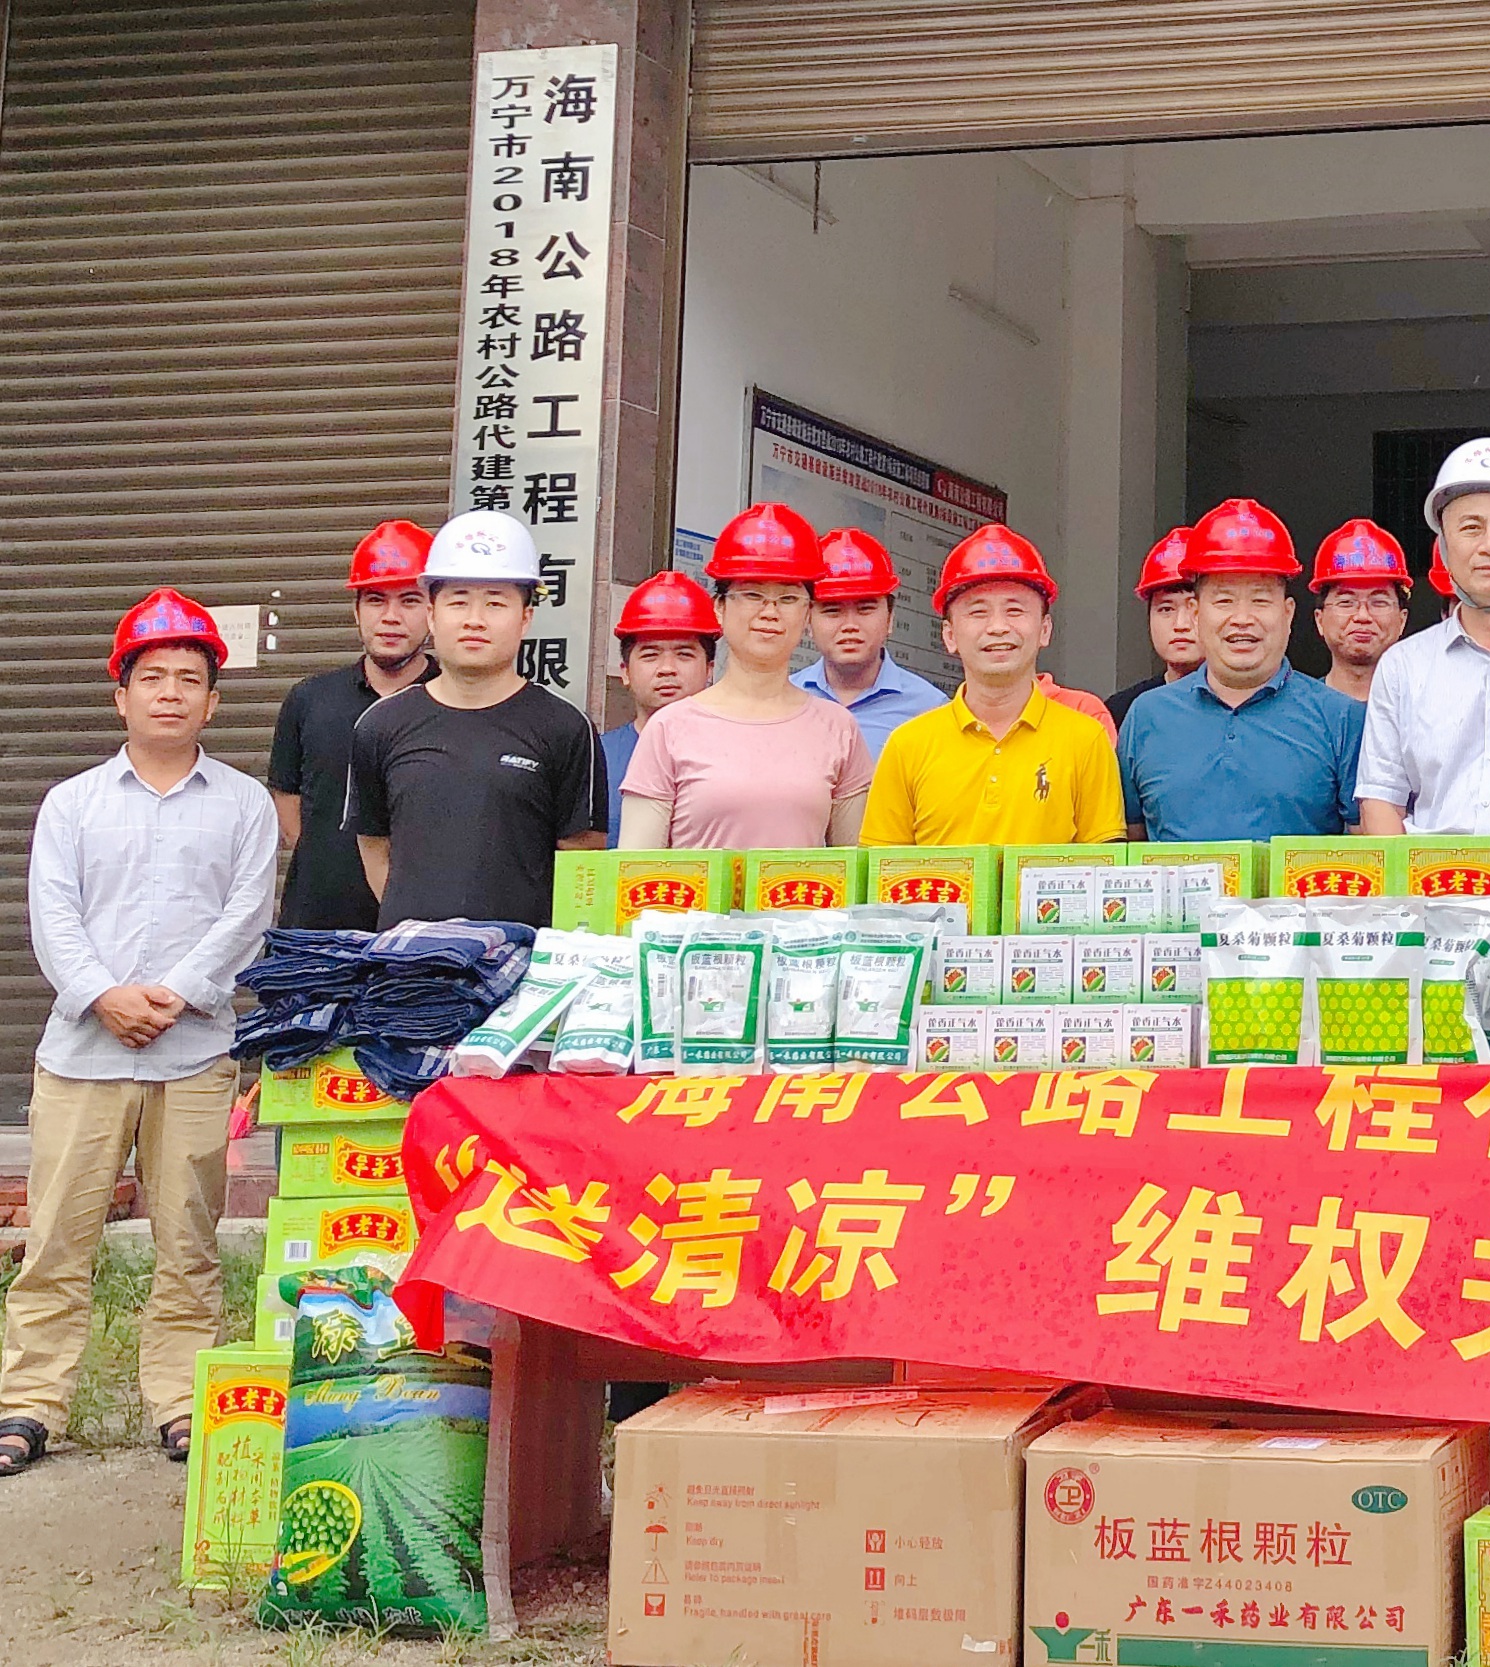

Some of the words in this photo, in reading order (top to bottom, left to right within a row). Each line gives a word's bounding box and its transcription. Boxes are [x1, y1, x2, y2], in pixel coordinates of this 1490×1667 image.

[772, 881, 828, 904] 王老吉
[896, 881, 955, 903] 王老吉
[1303, 871, 1363, 897] 王老吉
[1428, 869, 1490, 894] 王老吉
[635, 883, 690, 906] 王老吉
[1218, 932, 1292, 947] 夏桑菊颗粒
[1322, 932, 1395, 947] 夏桑菊颗粒
[339, 1216, 392, 1239] 王老吉
[374, 1373, 441, 1402] Bean
[223, 1387, 280, 1414] 王老吉
[1357, 1491, 1402, 1510] OTC
[1094, 1515, 1354, 1567] 板蓝根颗粒
[1124, 1595, 1406, 1633] 广东一禾药业有限公司
